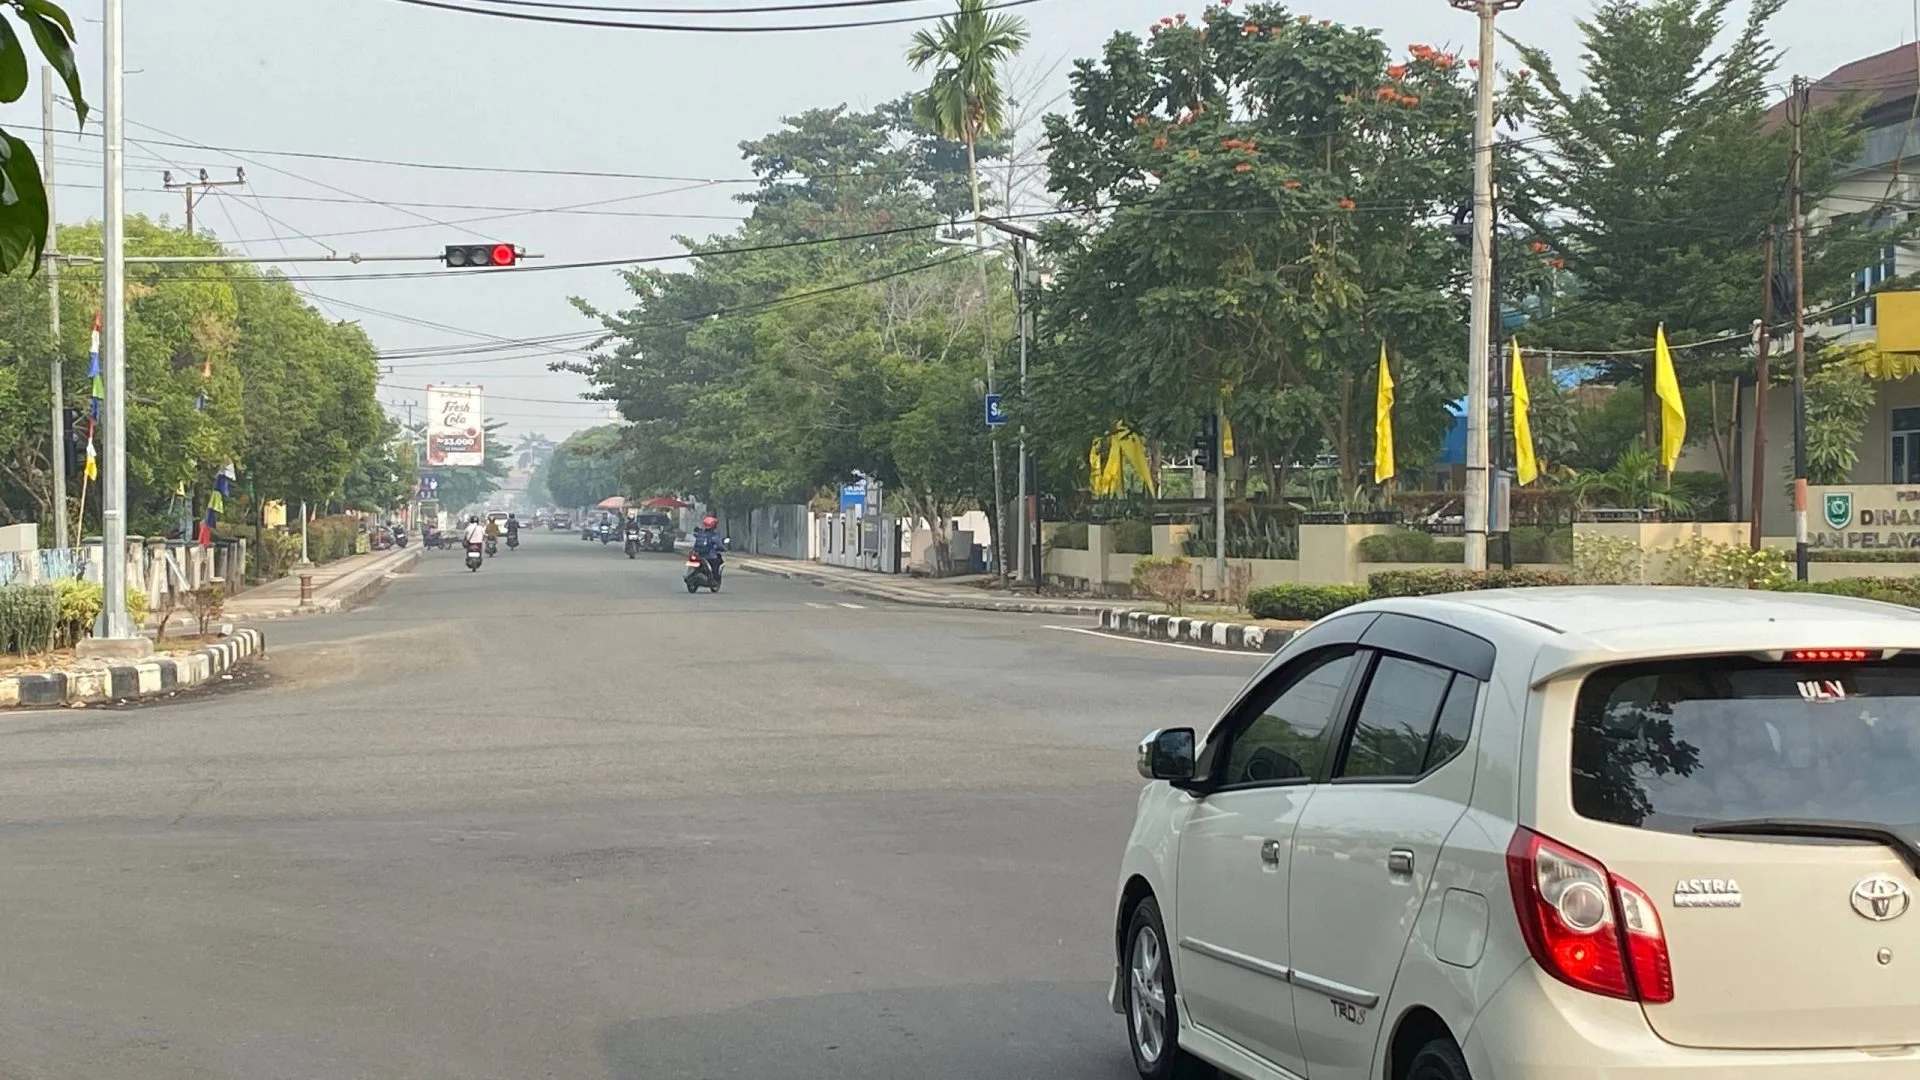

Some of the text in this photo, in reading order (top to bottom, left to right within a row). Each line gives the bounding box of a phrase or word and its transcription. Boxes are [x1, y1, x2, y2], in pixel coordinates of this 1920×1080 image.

[441, 400, 470, 413] Fresh
[444, 413, 466, 427] Cola
[1674, 878, 1741, 894] ASTRA
